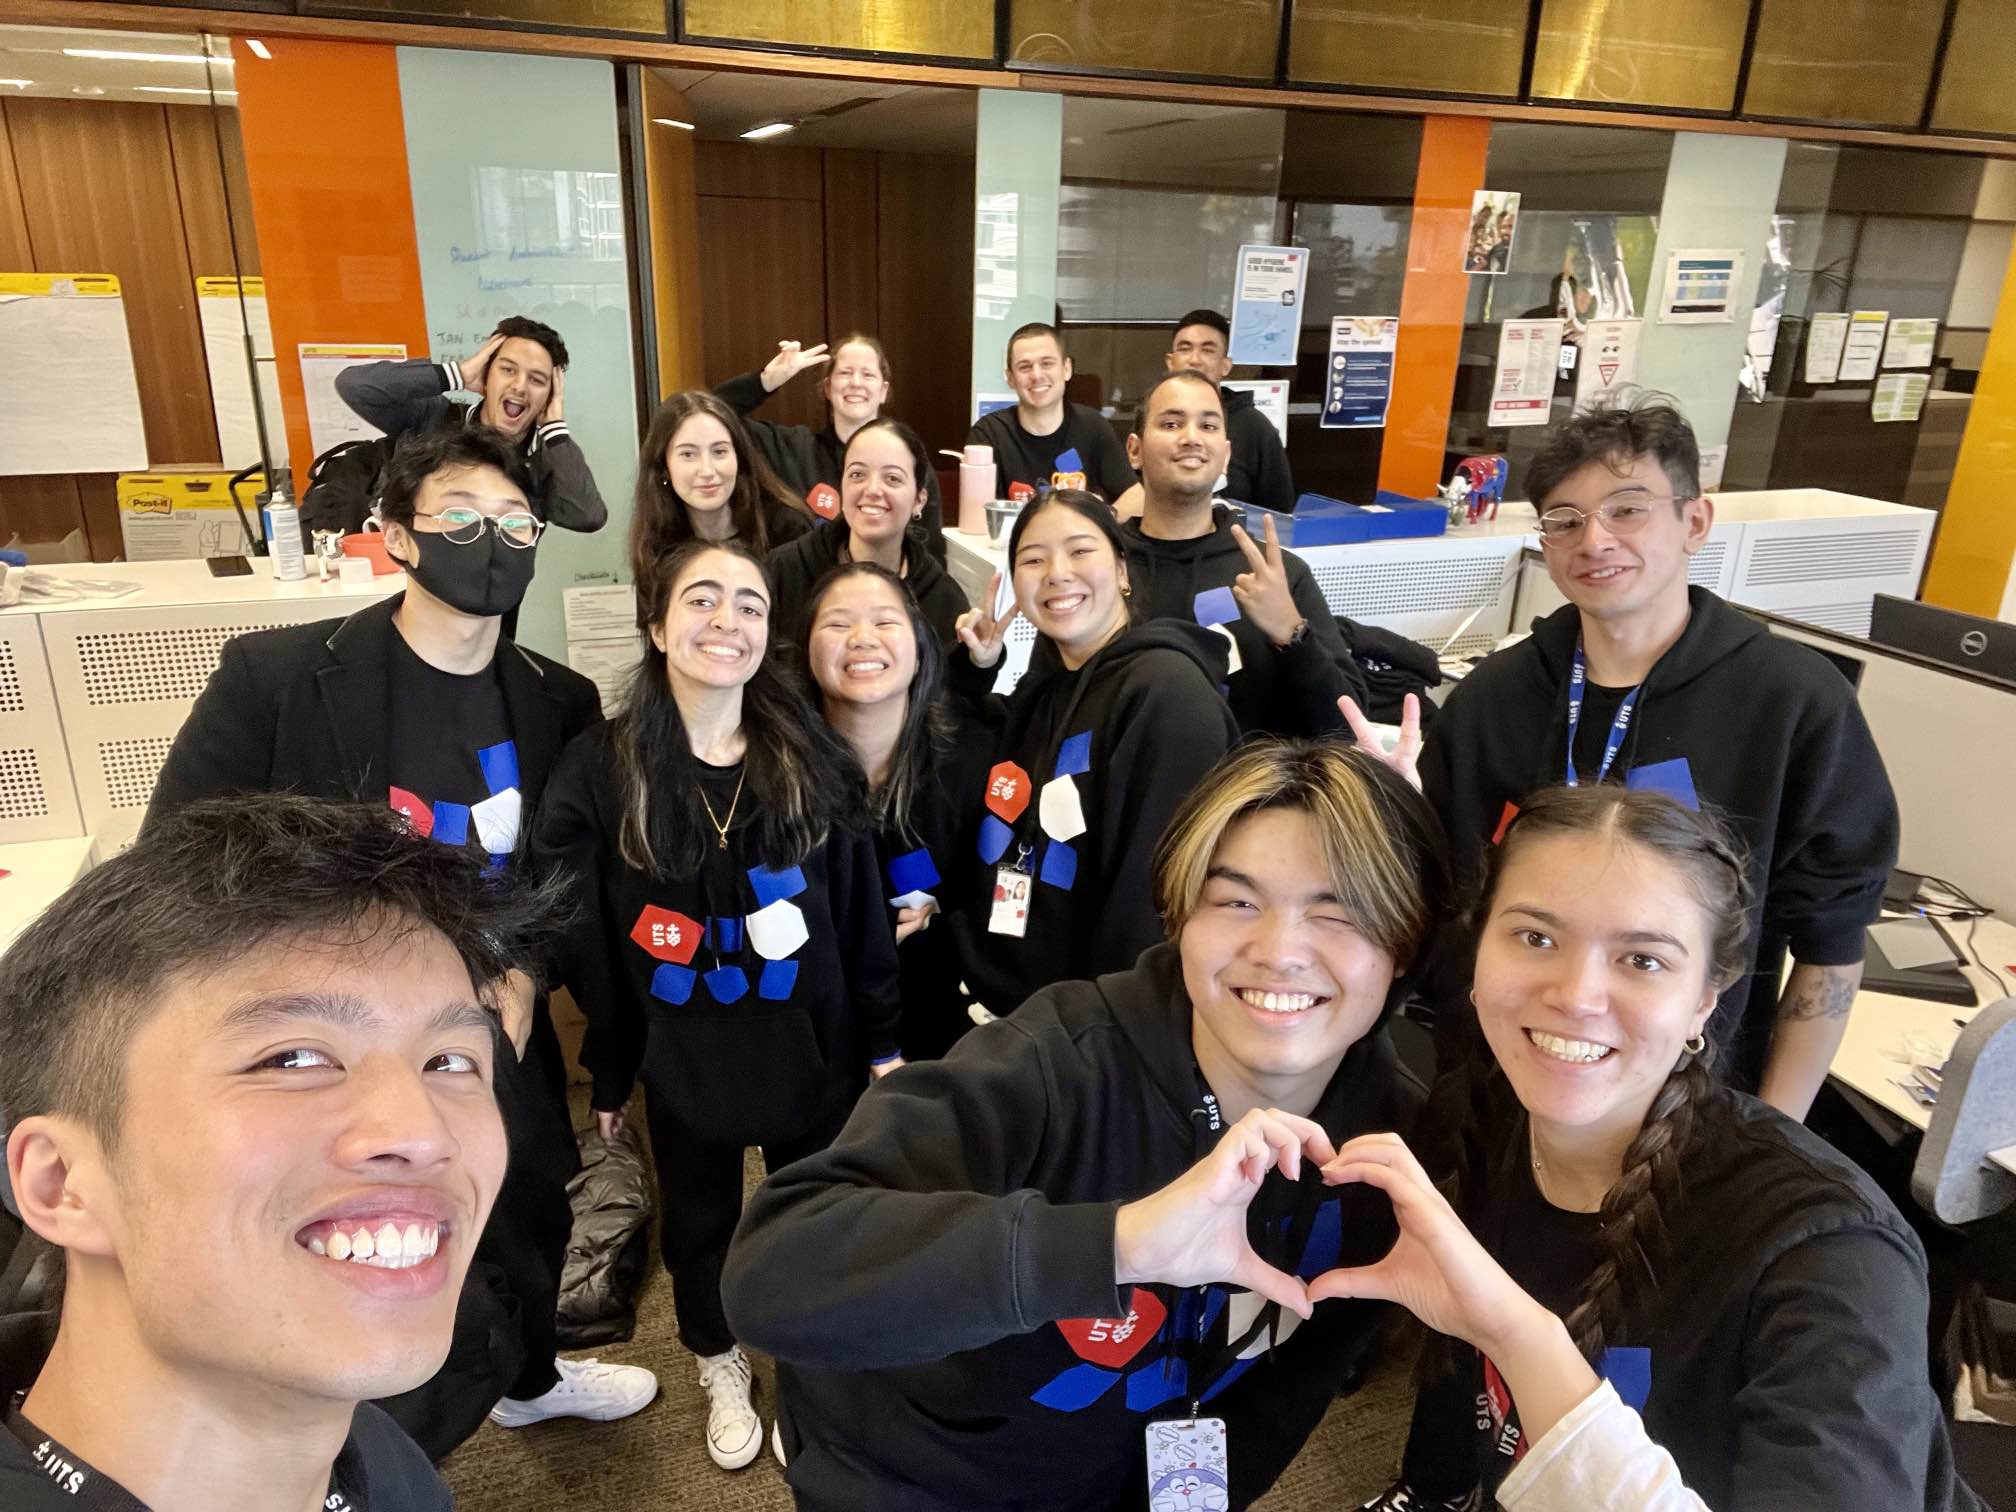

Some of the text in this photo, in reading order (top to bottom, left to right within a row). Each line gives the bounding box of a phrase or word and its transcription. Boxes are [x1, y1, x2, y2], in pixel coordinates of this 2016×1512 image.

[133, 499, 168, 508] Post-it
[991, 776, 1008, 796] UTS
[652, 923, 665, 946] UTS
[1209, 1104, 1220, 1130] UTS
[1088, 1318, 1112, 1342] UT
[1475, 1393, 1491, 1430] UTS
[1498, 1424, 1521, 1456] UTS
